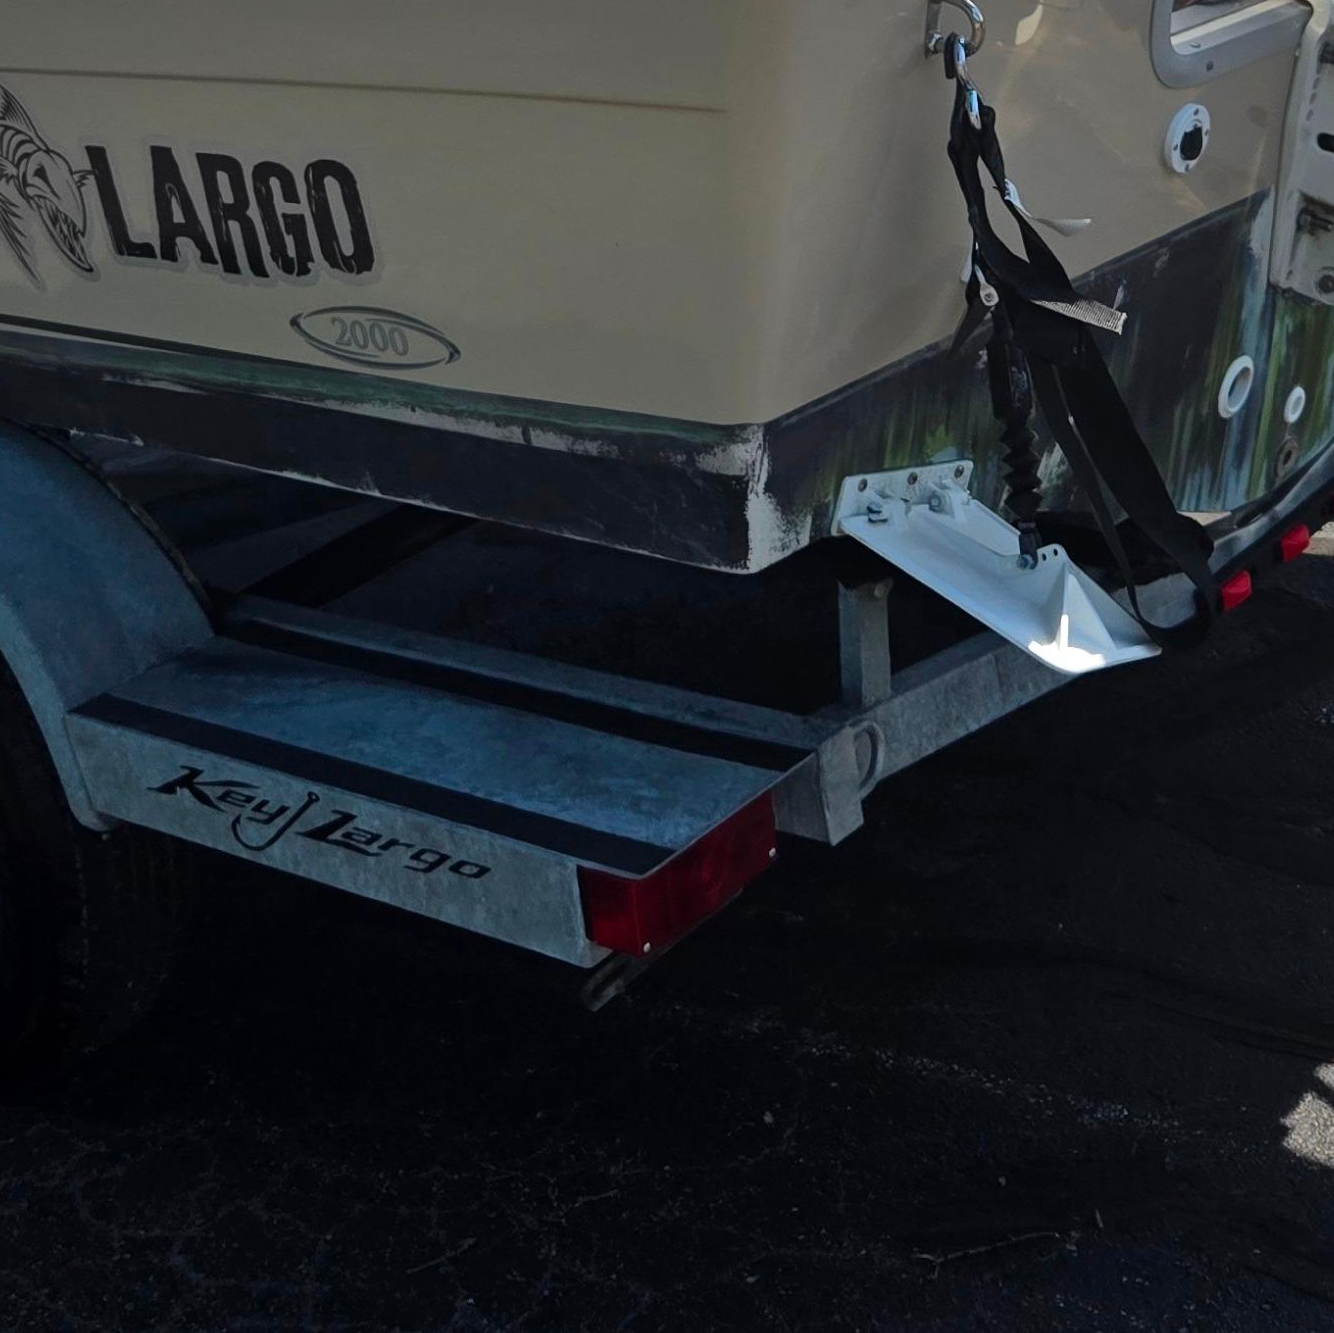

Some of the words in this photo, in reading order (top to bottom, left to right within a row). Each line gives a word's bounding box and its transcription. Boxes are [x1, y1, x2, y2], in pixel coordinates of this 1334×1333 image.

[85, 145, 376, 278] LARGO
[331, 316, 410, 356] 2000
[147, 765, 295, 828] Key
[295, 809, 492, 880] Largo
